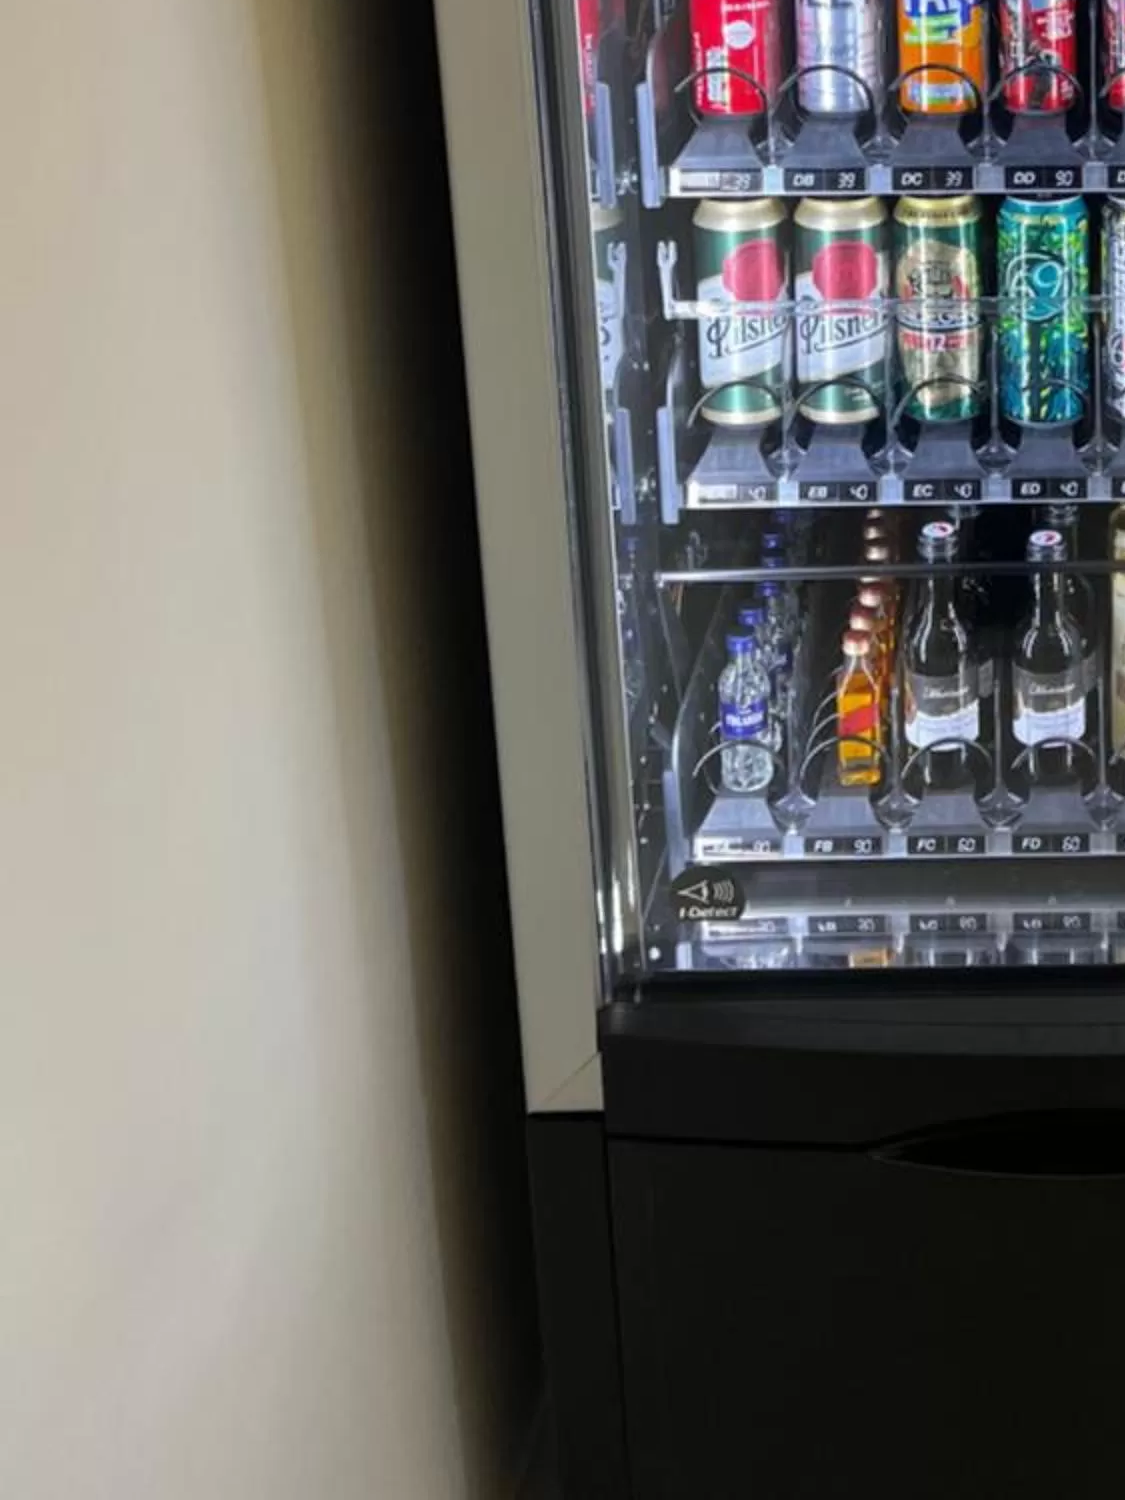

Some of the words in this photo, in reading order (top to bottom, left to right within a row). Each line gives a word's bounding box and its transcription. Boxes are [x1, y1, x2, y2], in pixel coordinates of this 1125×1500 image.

[792, 173, 815, 187] DB
[901, 172, 923, 186] DC
[1013, 171, 1036, 185] DD
[807, 485, 828, 498] EB
[912, 484, 933, 498] EC
[1020, 483, 1041, 496] ED
[813, 839, 834, 853] FB
[853, 838, 872, 854] 90
[916, 838, 937, 851] FC
[1021, 837, 1042, 850] FD
